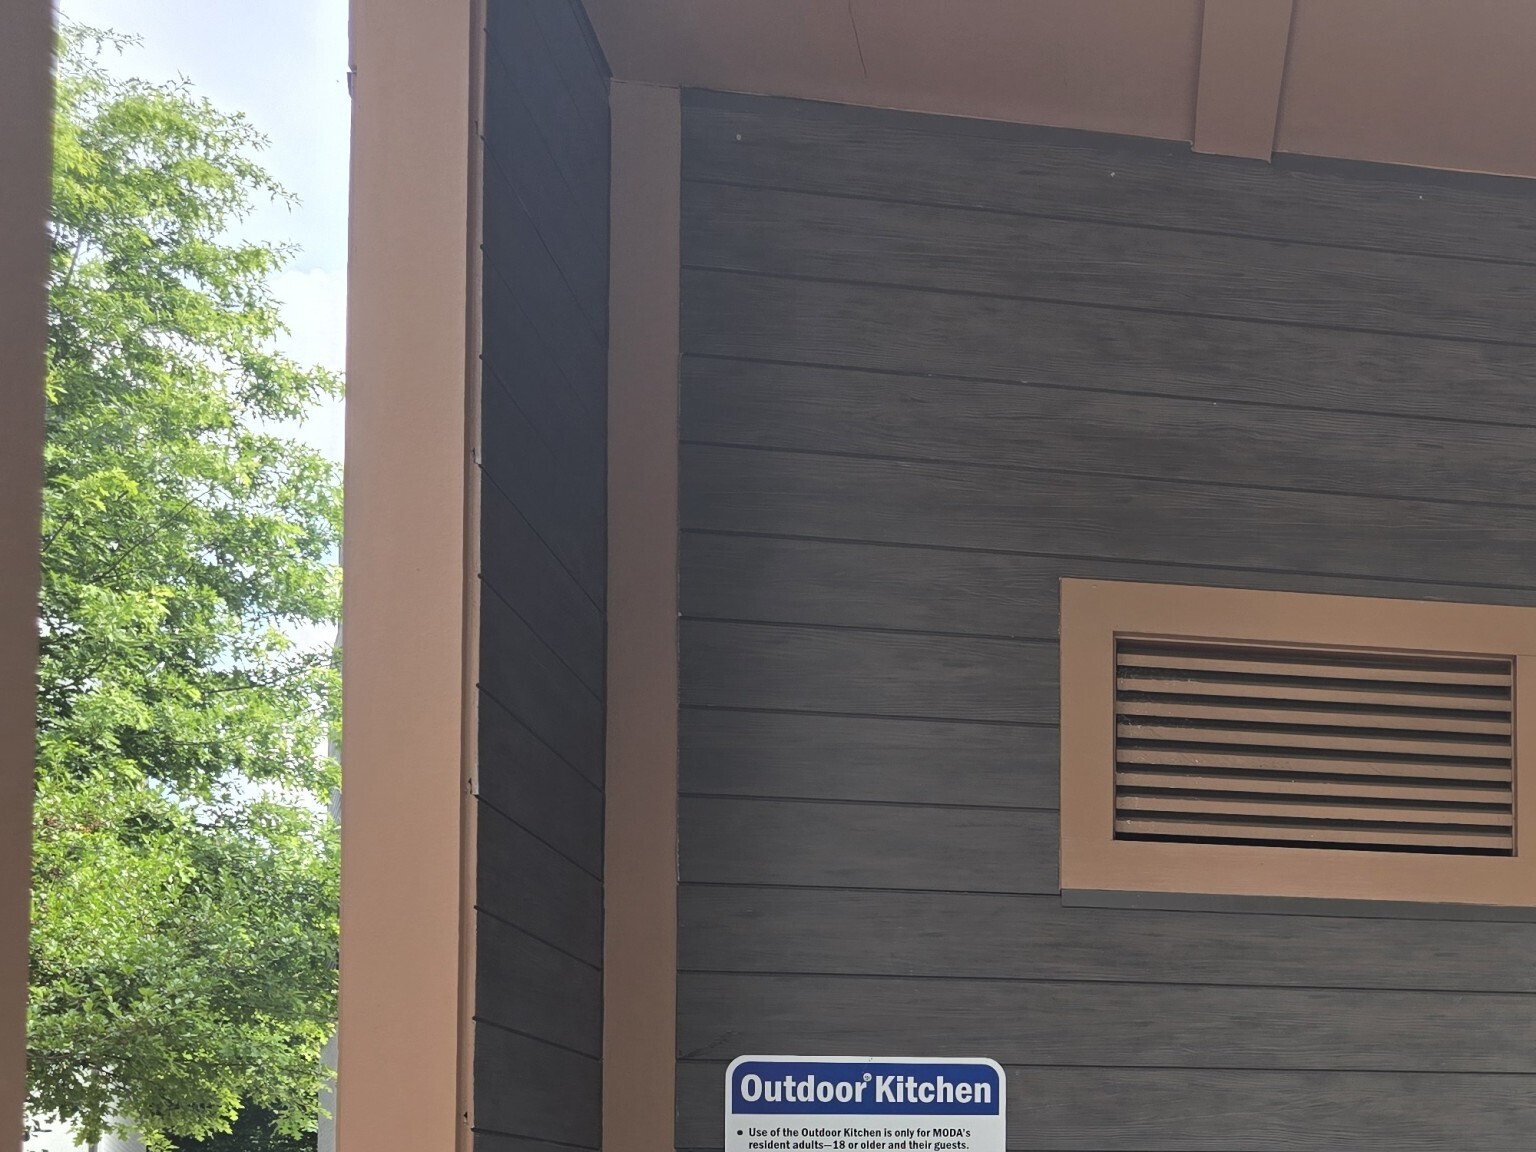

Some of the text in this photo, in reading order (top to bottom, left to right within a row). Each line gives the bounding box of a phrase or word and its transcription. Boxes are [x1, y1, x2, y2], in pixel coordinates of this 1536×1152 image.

[741, 1073, 992, 1104] Outdoor Kitchen
[749, 1128, 970, 1139] Use of the Outdoor Kitchen is only for MODA's
[749, 1140, 790, 1149] resident
[861, 1140, 886, 1149] older
[888, 1140, 906, 1149] and
[909, 1140, 932, 1149] their
[934, 1141, 968, 1151] guests.
